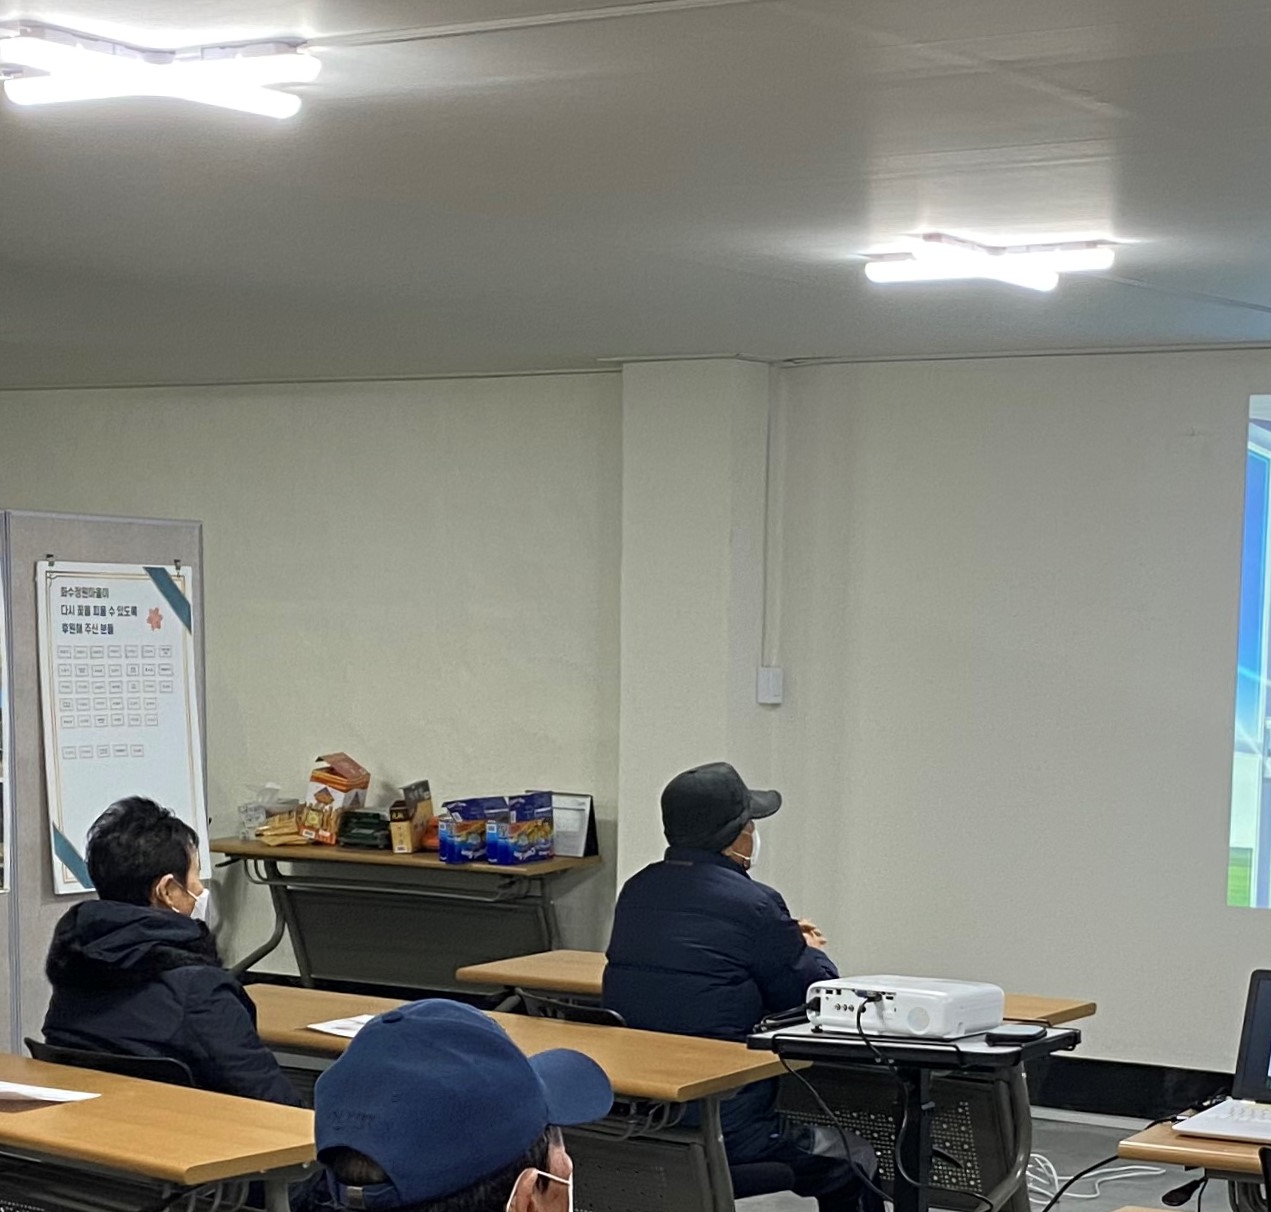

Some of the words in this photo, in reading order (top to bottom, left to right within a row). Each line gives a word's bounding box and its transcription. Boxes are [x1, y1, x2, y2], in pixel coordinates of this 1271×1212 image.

[60, 604, 75, 616] 다시
[108, 606, 116, 617] 수
[84, 622, 99, 635] 주신
